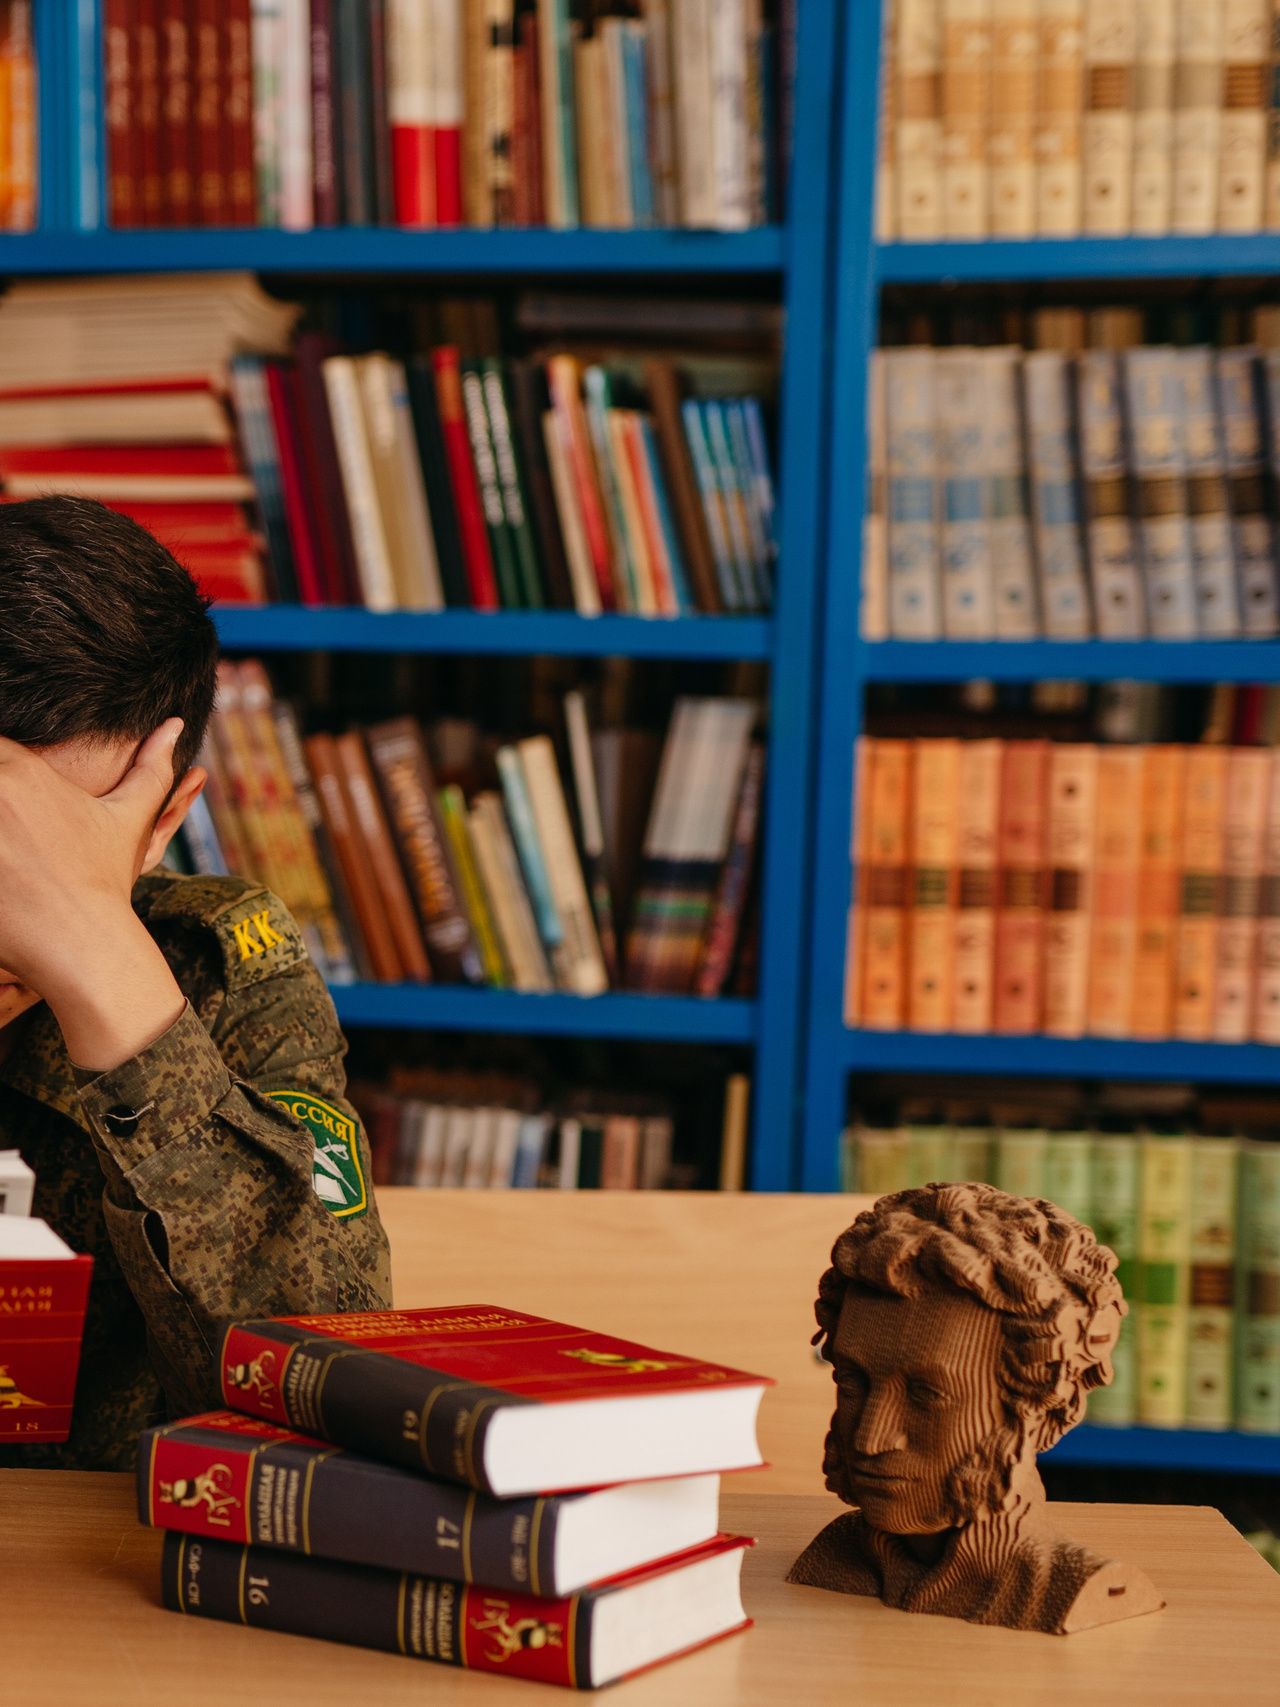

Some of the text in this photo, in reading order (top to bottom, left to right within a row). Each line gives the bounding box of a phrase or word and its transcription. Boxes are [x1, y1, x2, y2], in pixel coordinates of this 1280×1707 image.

[233, 910, 284, 962] КК
[436, 1516, 460, 1549] 17
[248, 1576, 270, 1606] 16
